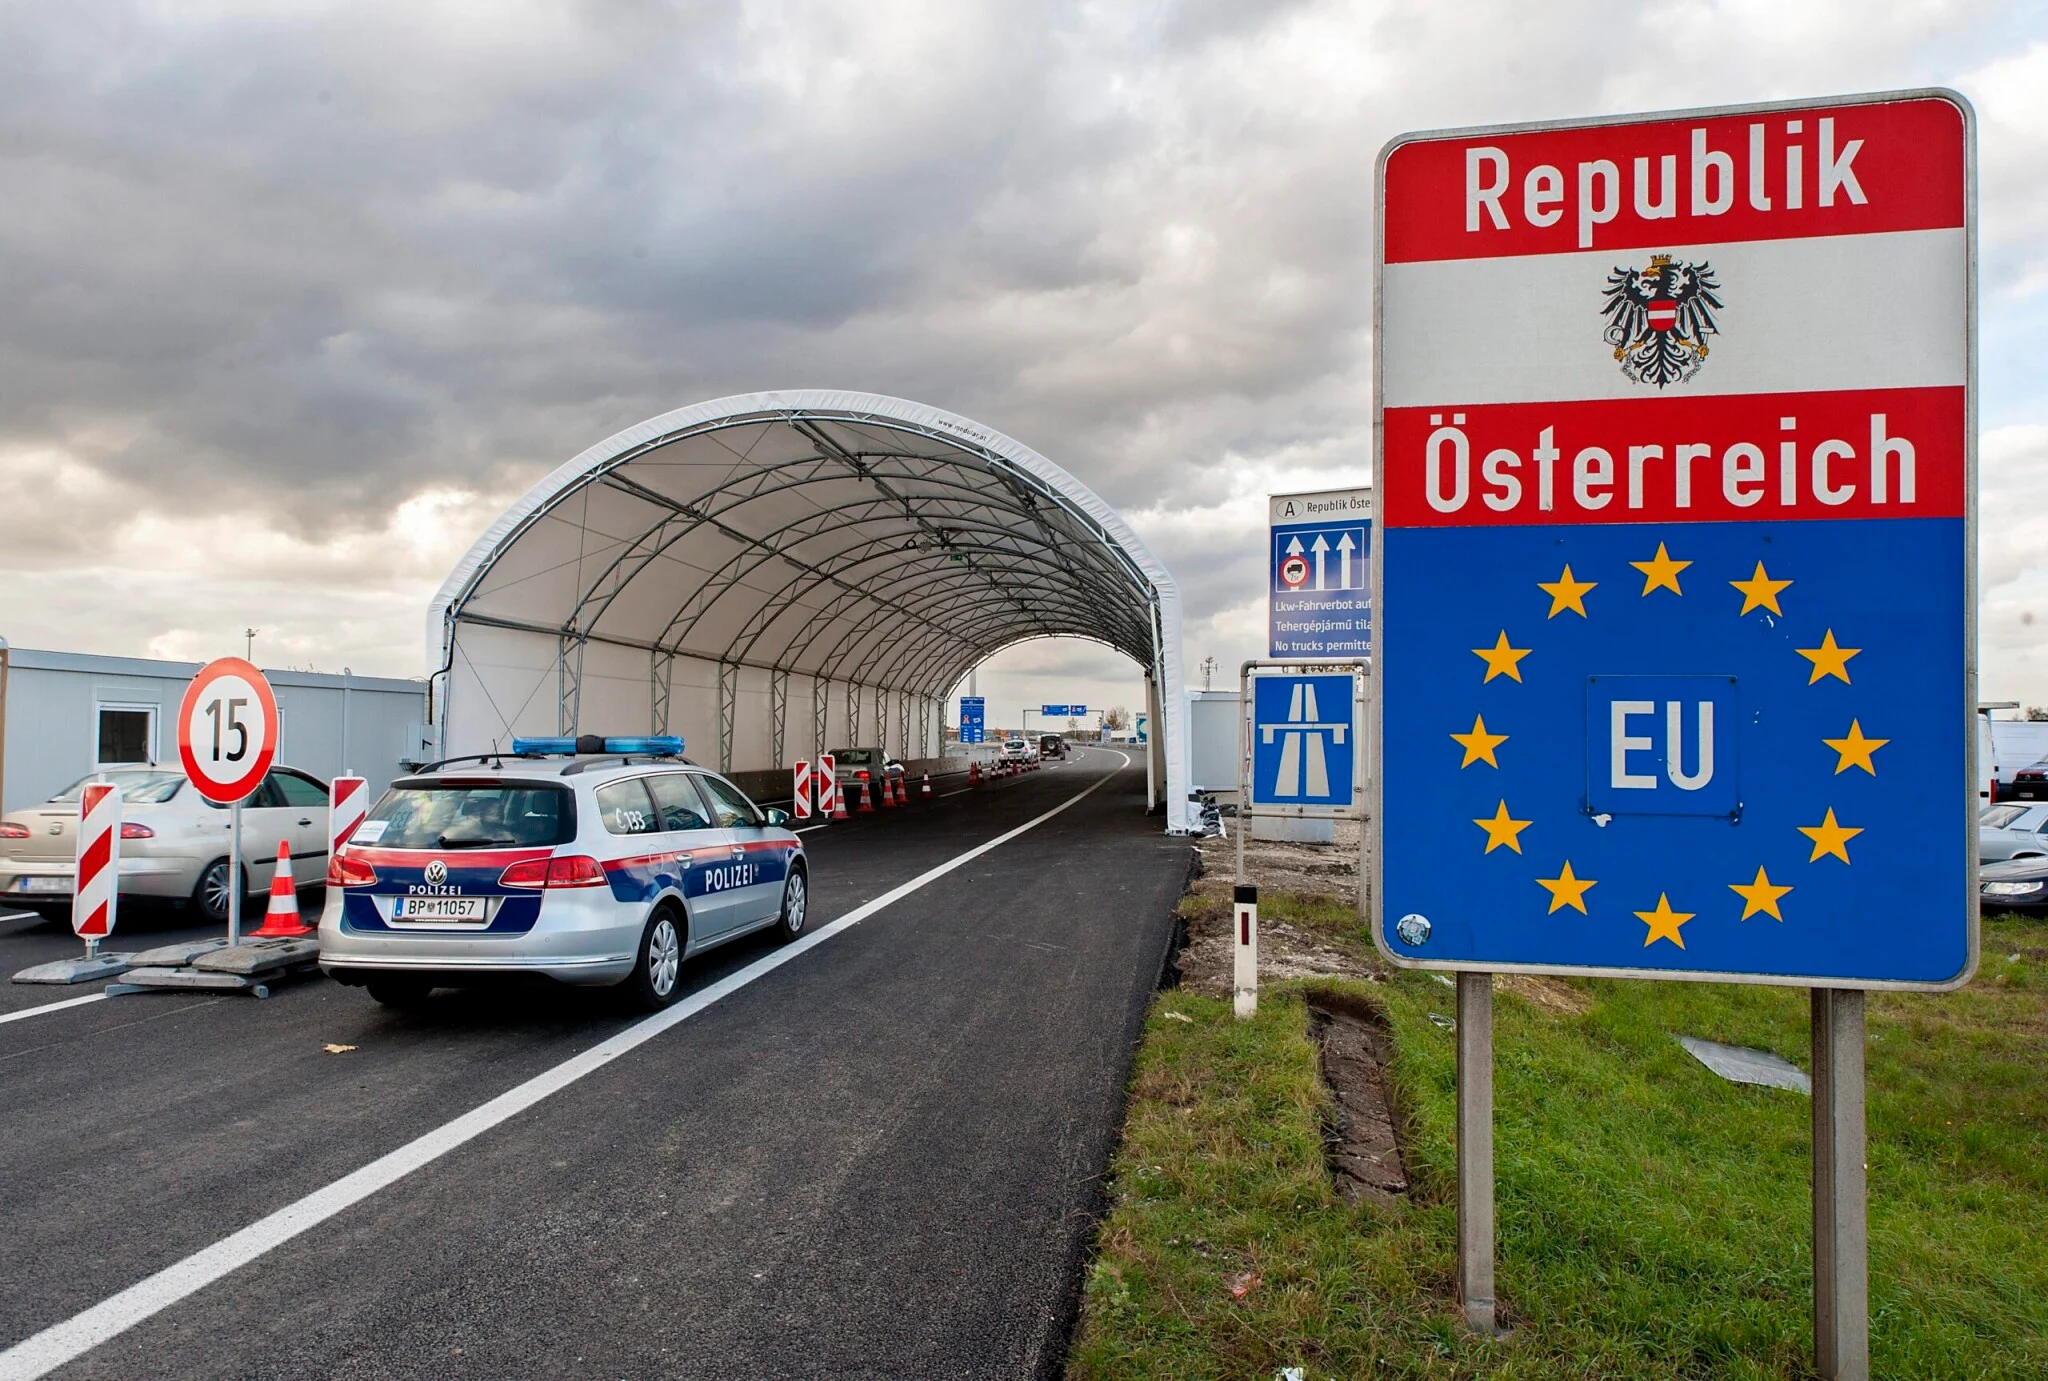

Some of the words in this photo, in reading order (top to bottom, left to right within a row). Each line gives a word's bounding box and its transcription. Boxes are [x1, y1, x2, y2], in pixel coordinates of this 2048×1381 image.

[1465, 117, 1868, 248] Republik
[1425, 413, 1916, 513] Österreich
[1285, 502, 1295, 516] A
[1307, 499, 1348, 514] Republik
[1275, 599, 1353, 612] Lkw-Fahrverbot
[1275, 619, 1352, 633] Tehergépjármű
[1275, 641, 1288, 651] No
[1292, 640, 1323, 651] trucks
[205, 698, 248, 761] 15
[1611, 700, 1714, 791] EU
[624, 810, 646, 831] 133
[705, 863, 753, 892] POLIZEI
[409, 885, 462, 895] POLIZEI
[408, 900, 426, 915] BP
[437, 900, 475, 915] 11057
